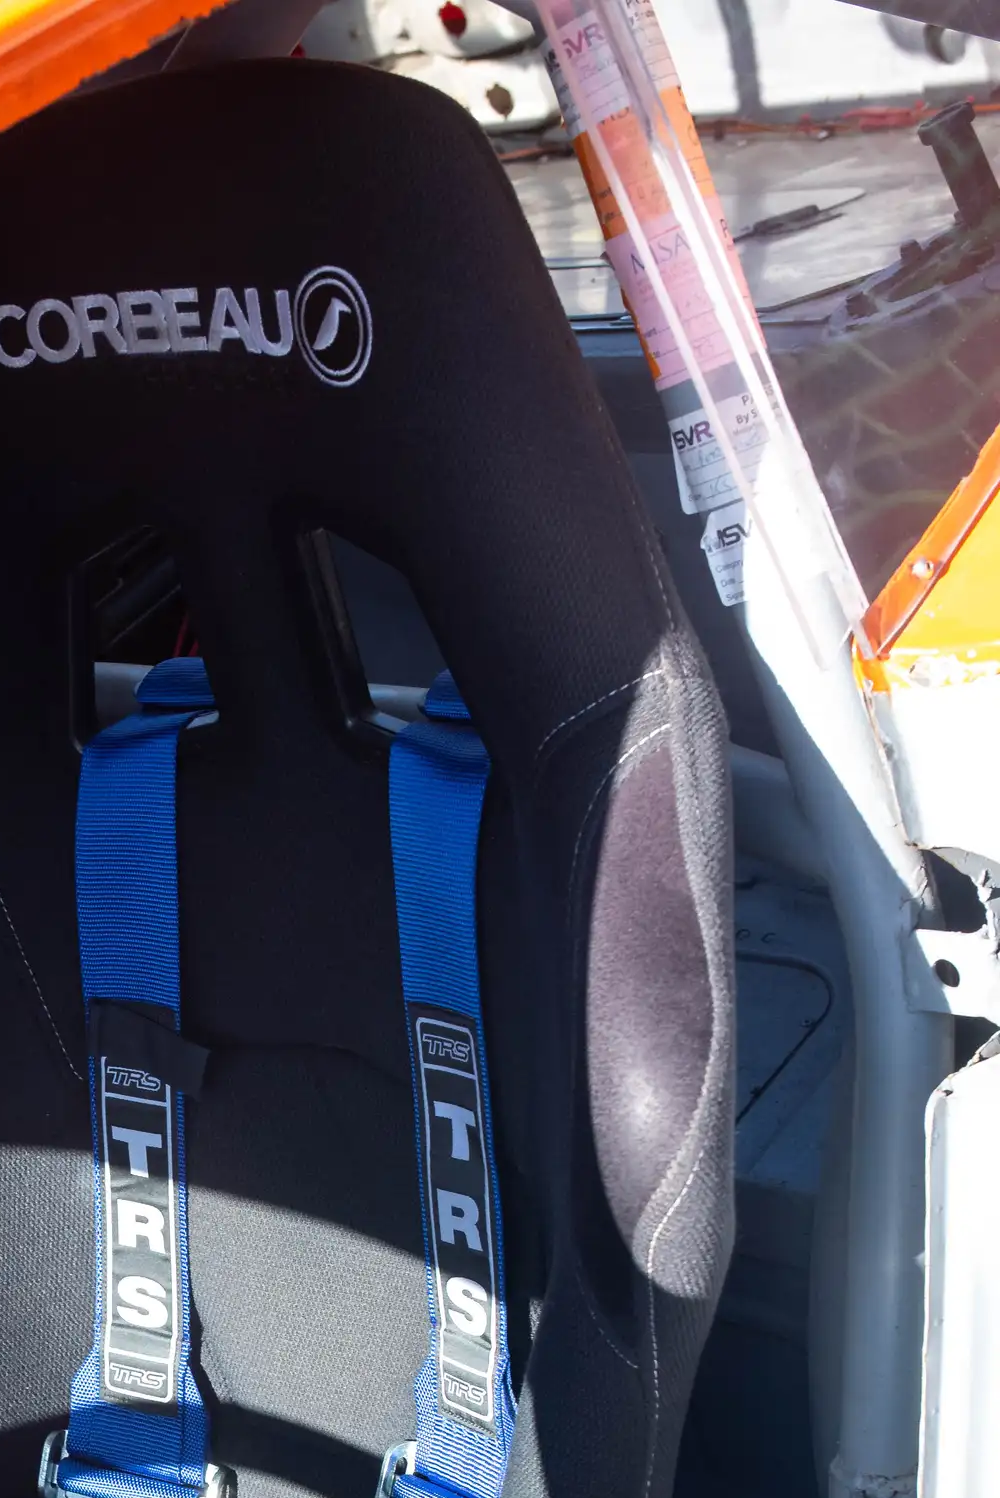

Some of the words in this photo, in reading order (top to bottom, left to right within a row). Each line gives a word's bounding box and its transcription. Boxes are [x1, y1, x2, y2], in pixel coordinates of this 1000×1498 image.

[422, 1034, 471, 1063] TRS
[107, 1066, 161, 1093] TRS
[111, 1126, 169, 1330] TRS
[433, 1101, 488, 1337] TRS
[109, 1364, 166, 1388] TRS
[443, 1376, 487, 1405] TRS
